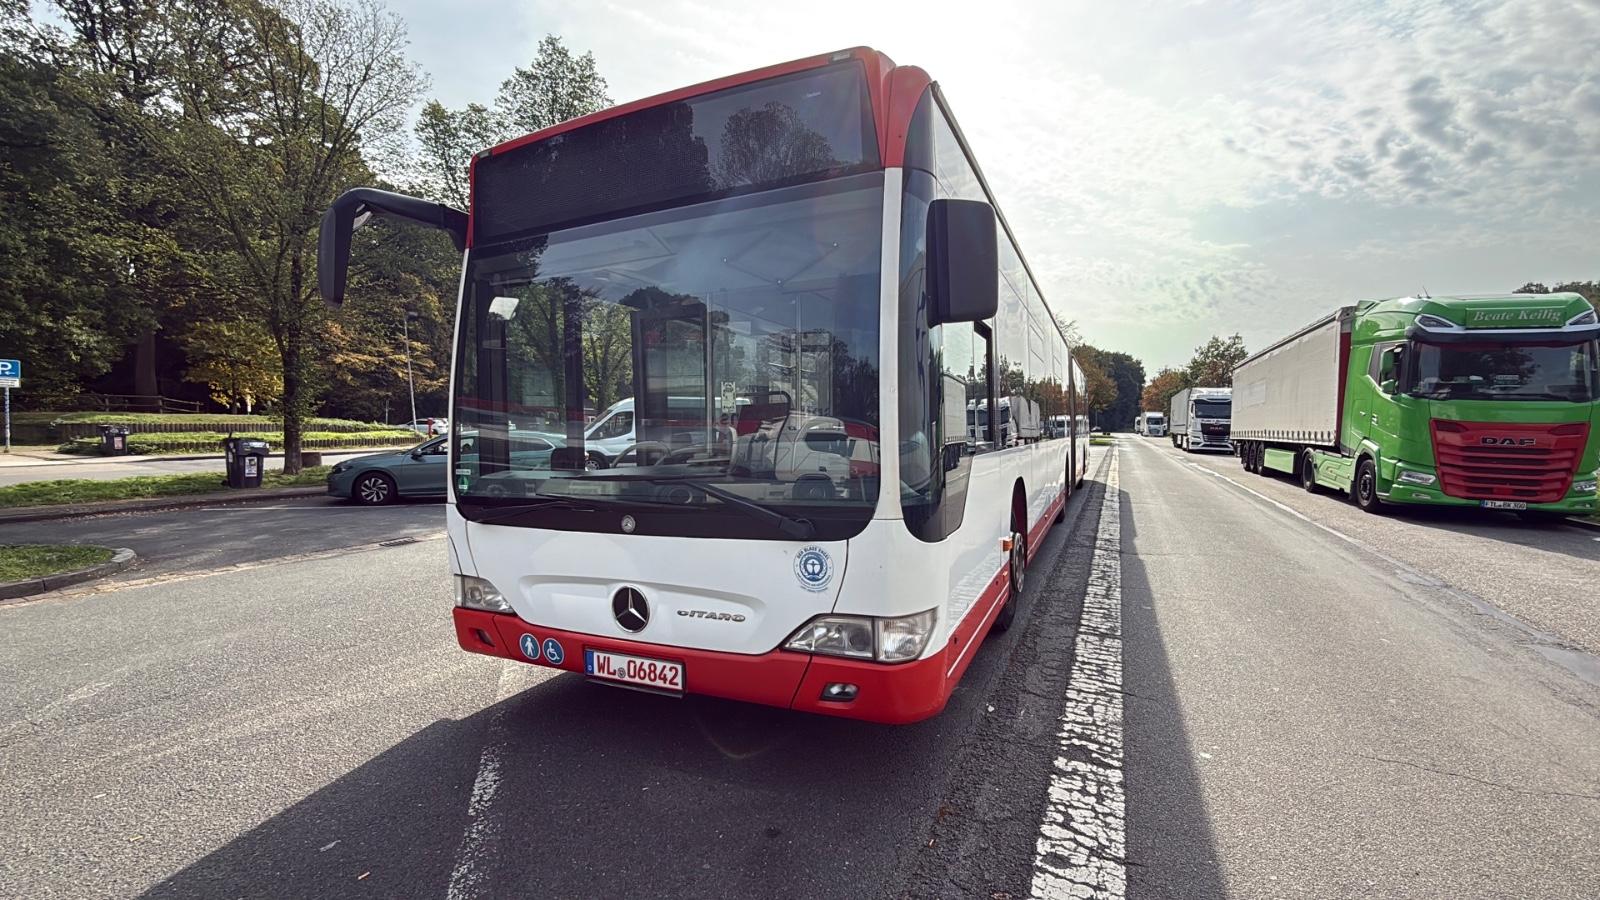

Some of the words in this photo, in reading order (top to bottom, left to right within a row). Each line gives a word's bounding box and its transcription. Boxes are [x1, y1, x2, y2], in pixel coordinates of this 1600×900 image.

[1473, 310, 1514, 321] Beate
[1518, 308, 1561, 322] Keilig
[0, 361, 12, 375] P
[1481, 436, 1537, 446] DAF
[596, 654, 617, 676] WL
[626, 659, 679, 686] 06842
